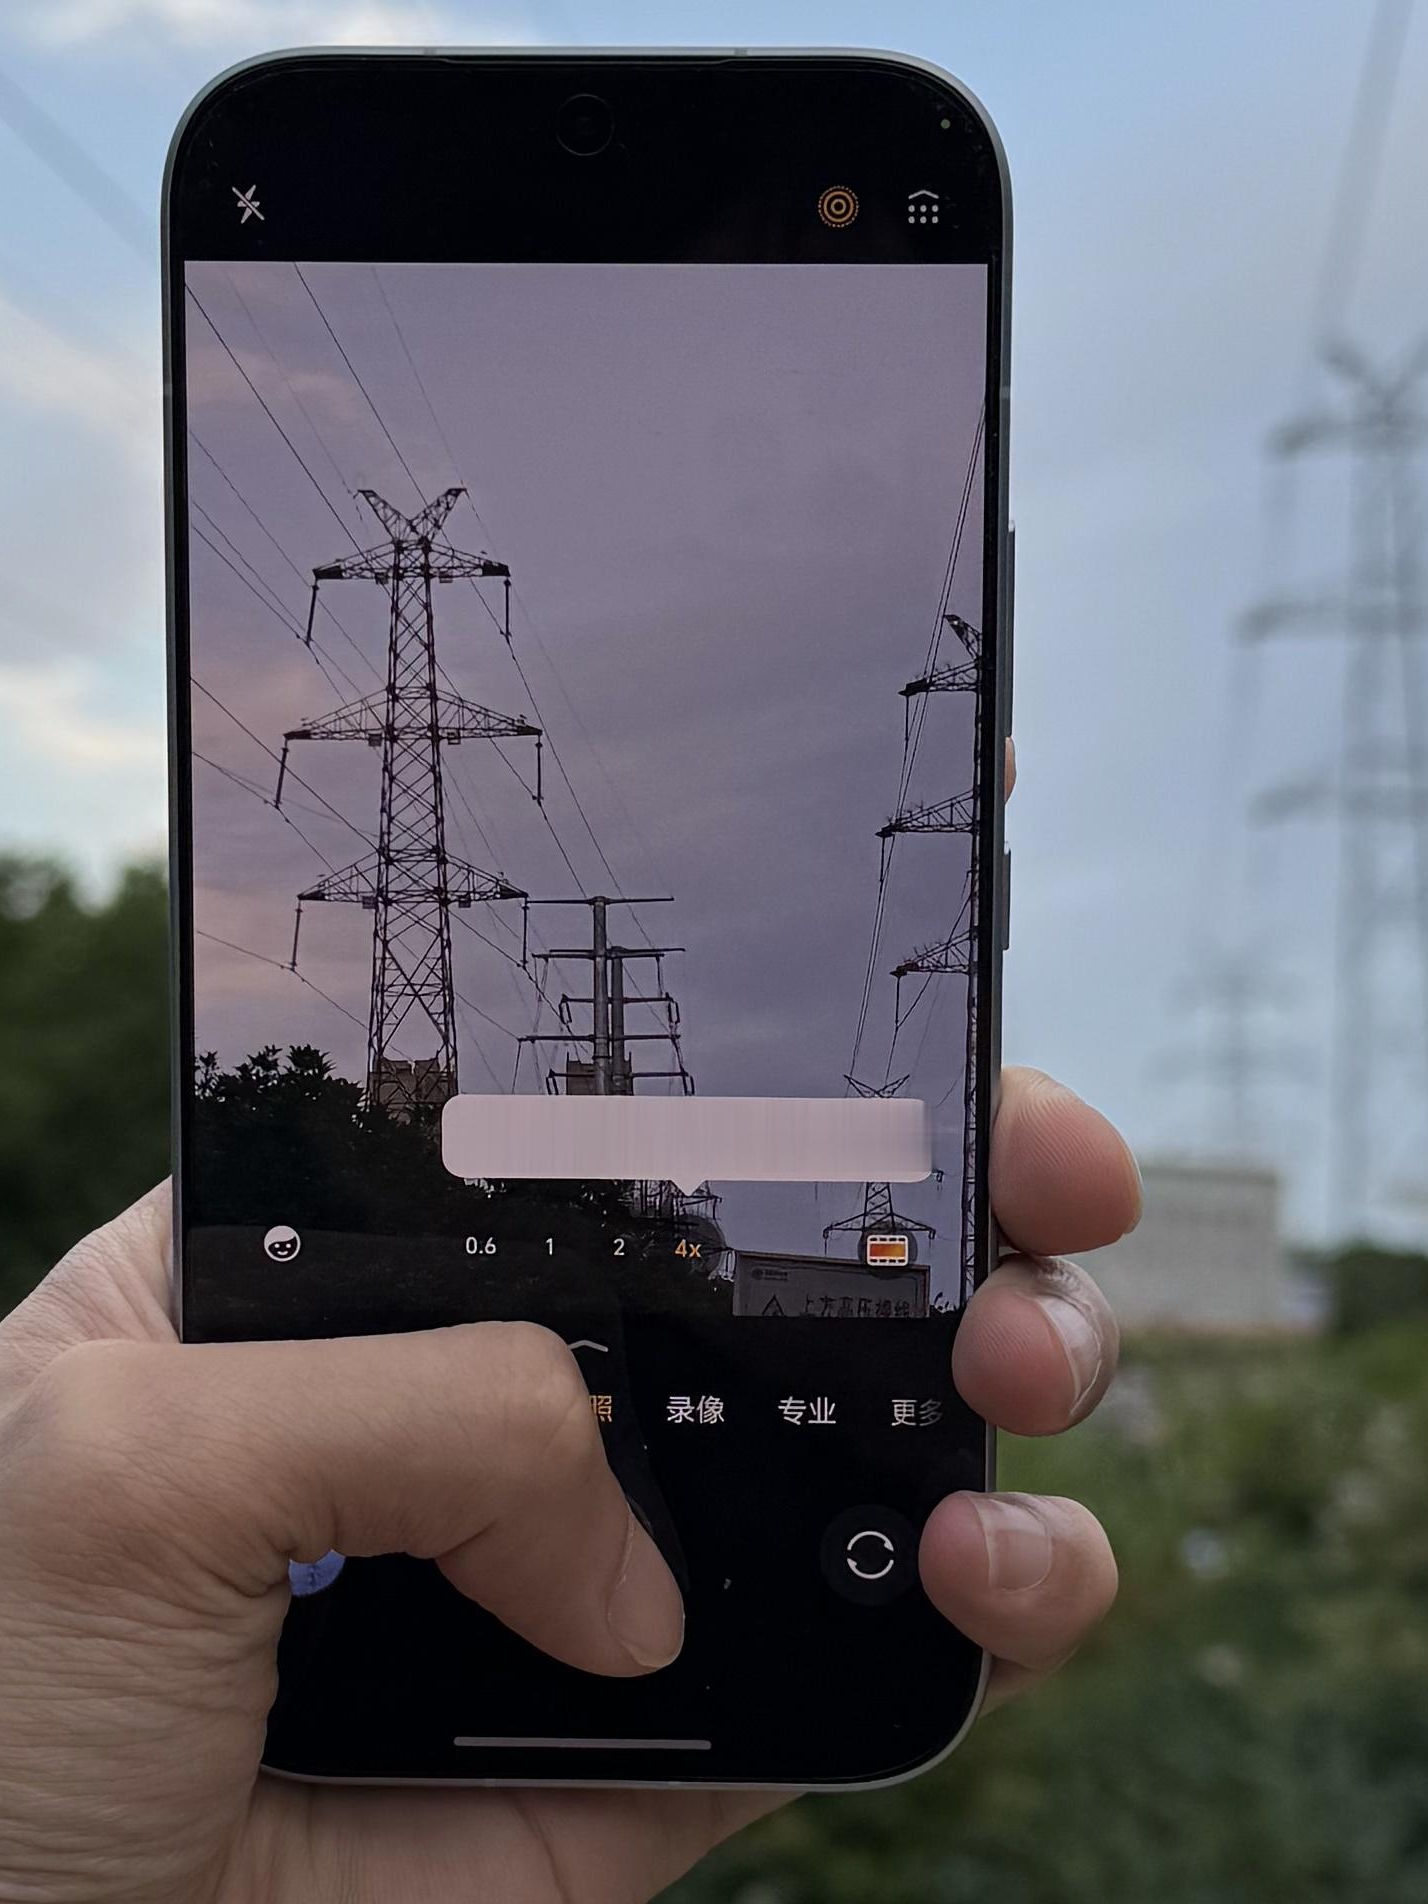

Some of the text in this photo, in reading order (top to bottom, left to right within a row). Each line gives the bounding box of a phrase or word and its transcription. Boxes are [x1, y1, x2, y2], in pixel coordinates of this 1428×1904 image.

[465, 1236, 702, 1258] 0.6 1 2 4x
[666, 1395, 725, 1424] 录像
[777, 1396, 837, 1426] 专业
[891, 1398, 943, 1427] 更多
